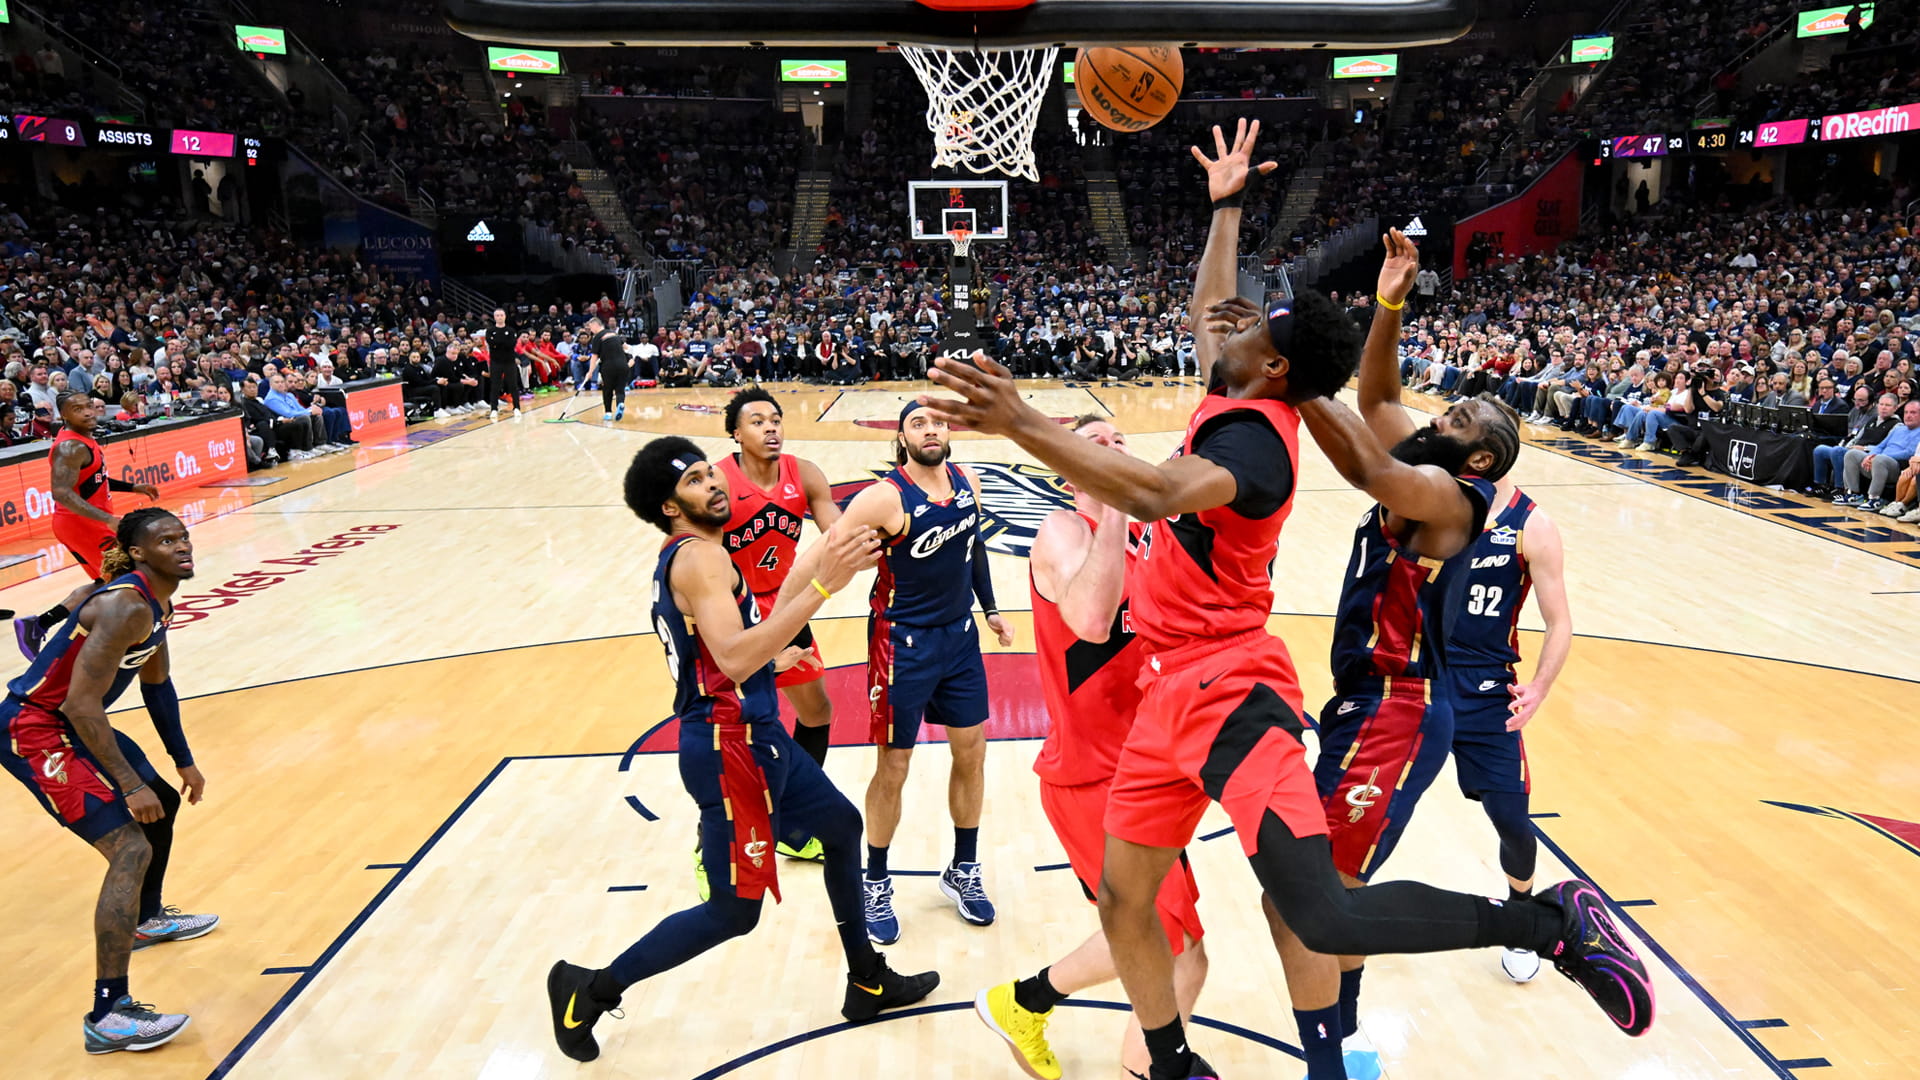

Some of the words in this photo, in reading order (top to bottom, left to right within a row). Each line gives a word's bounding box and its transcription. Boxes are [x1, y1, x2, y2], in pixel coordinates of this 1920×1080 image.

[506, 58, 543, 68] SERVPRO
[1845, 107, 1910, 137] Redfin
[65, 126, 76, 141] 9
[98, 129, 152, 146] ASSISTS
[1698, 133, 1726, 148] 4:30
[1740, 130, 1753, 144] 24
[1760, 127, 1778, 143] 42
[1812, 129, 1819, 140] 4
[182, 136, 201, 151] 12
[1643, 137, 1662, 153] 47
[1669, 138, 1683, 149] 2Q
[246, 149, 258, 159] 52
[1603, 147, 1609, 158] 3
[363, 236, 432, 249] LECOM
[466, 232, 495, 242] adidas
[208, 441, 225, 459] fire
[226, 438, 236, 455] tv
[121, 462, 174, 487] Game.
[175, 451, 201, 479] On.
[1492, 536, 1516, 545] CLIFFS
[756, 546, 779, 571] 4
[167, 569, 307, 630] ocket
[259, 524, 403, 566] Arena
[1467, 584, 1504, 617] 32
